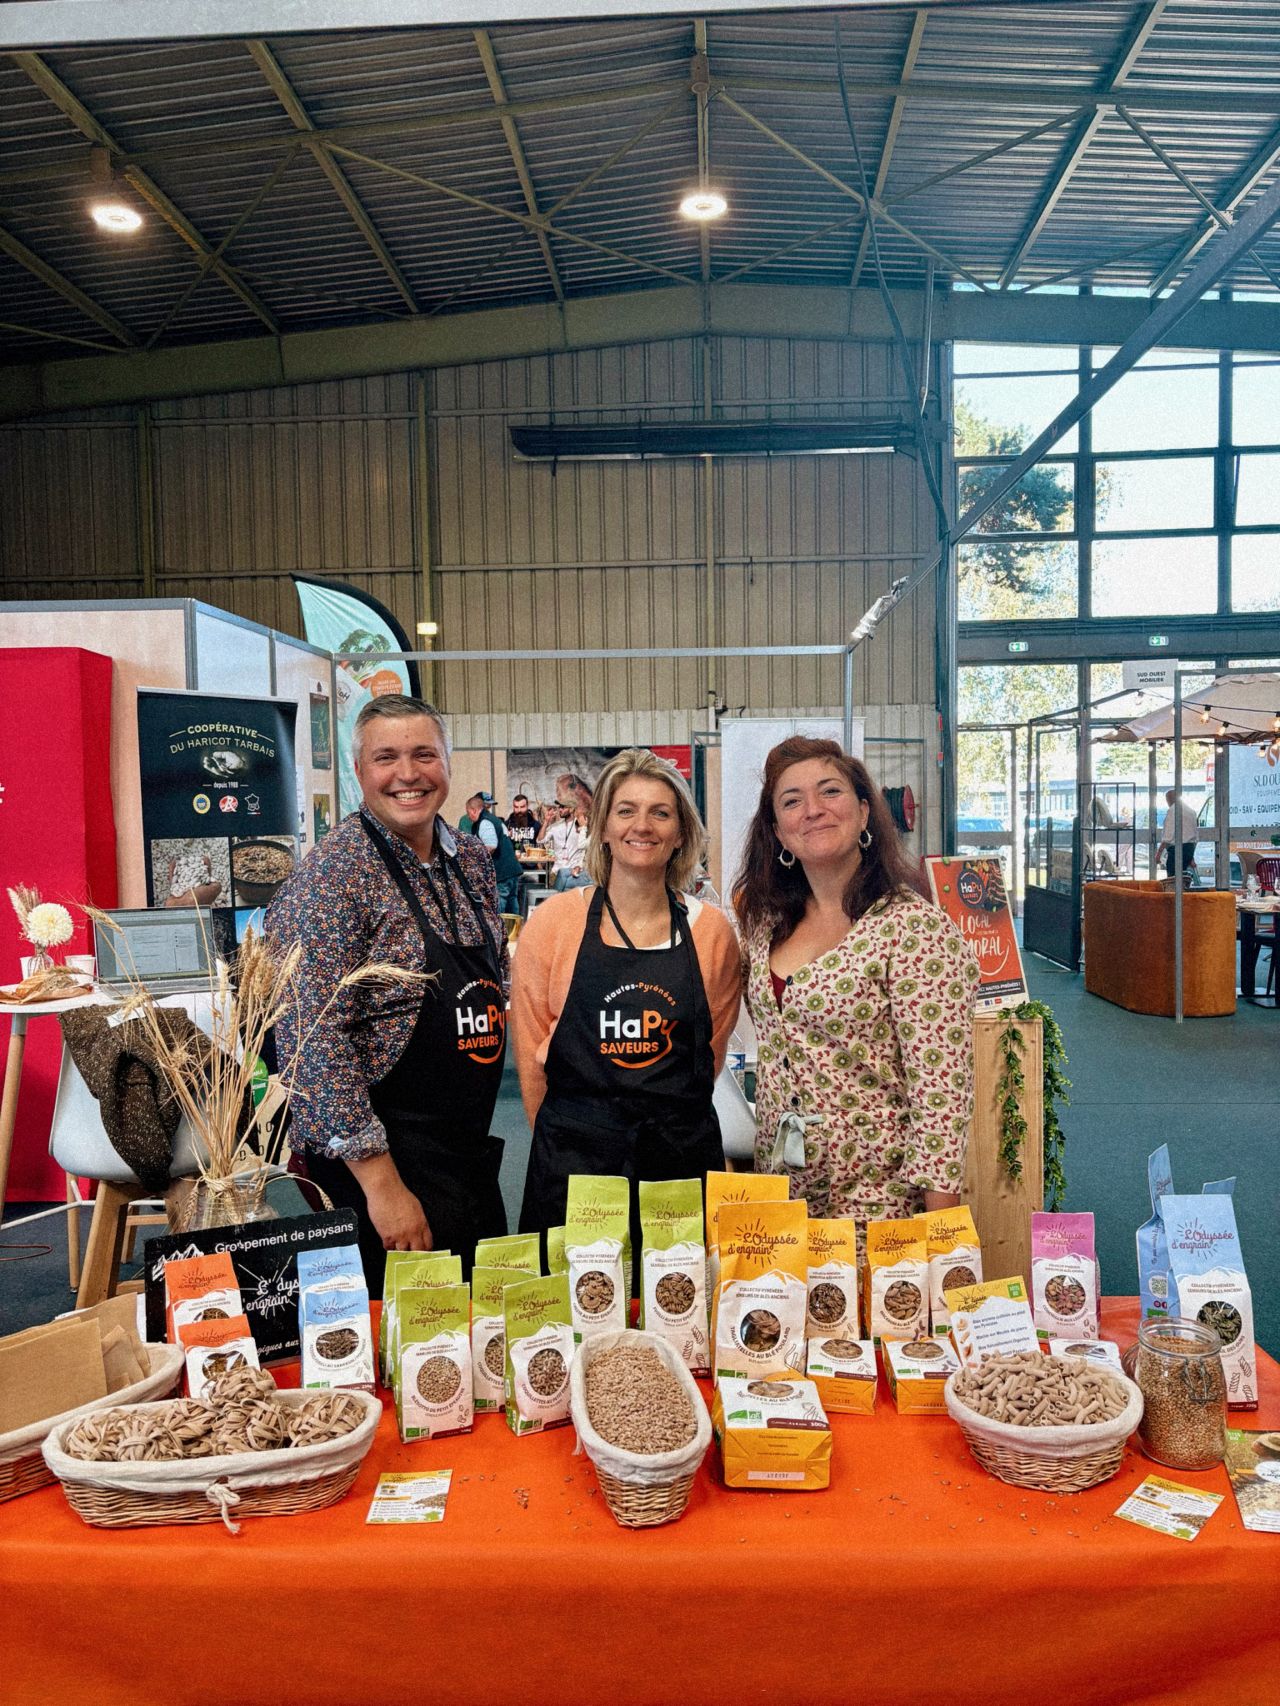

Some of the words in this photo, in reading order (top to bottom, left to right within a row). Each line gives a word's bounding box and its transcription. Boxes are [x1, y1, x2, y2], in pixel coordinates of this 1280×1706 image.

[187, 722, 258, 738] COOPÉRATIVE
[170, 742, 185, 754] DU
[187, 737, 232, 749] HARICOT
[234, 738, 275, 758] TARBAIS
[1242, 805, 1253, 814] SAV
[961, 911, 991, 935] LOCAL
[604, 981, 677, 1006] Hautes-Pyrénées
[600, 1010, 679, 1039] HaPy
[458, 1035, 499, 1050] SAVEURS
[600, 1042, 660, 1054] SAVEURS
[291, 1230, 305, 1241] de
[308, 1223, 354, 1239] paysans
[728, 1244, 771, 1260] d'engrain
[765, 1351, 775, 1359] BLÉ
